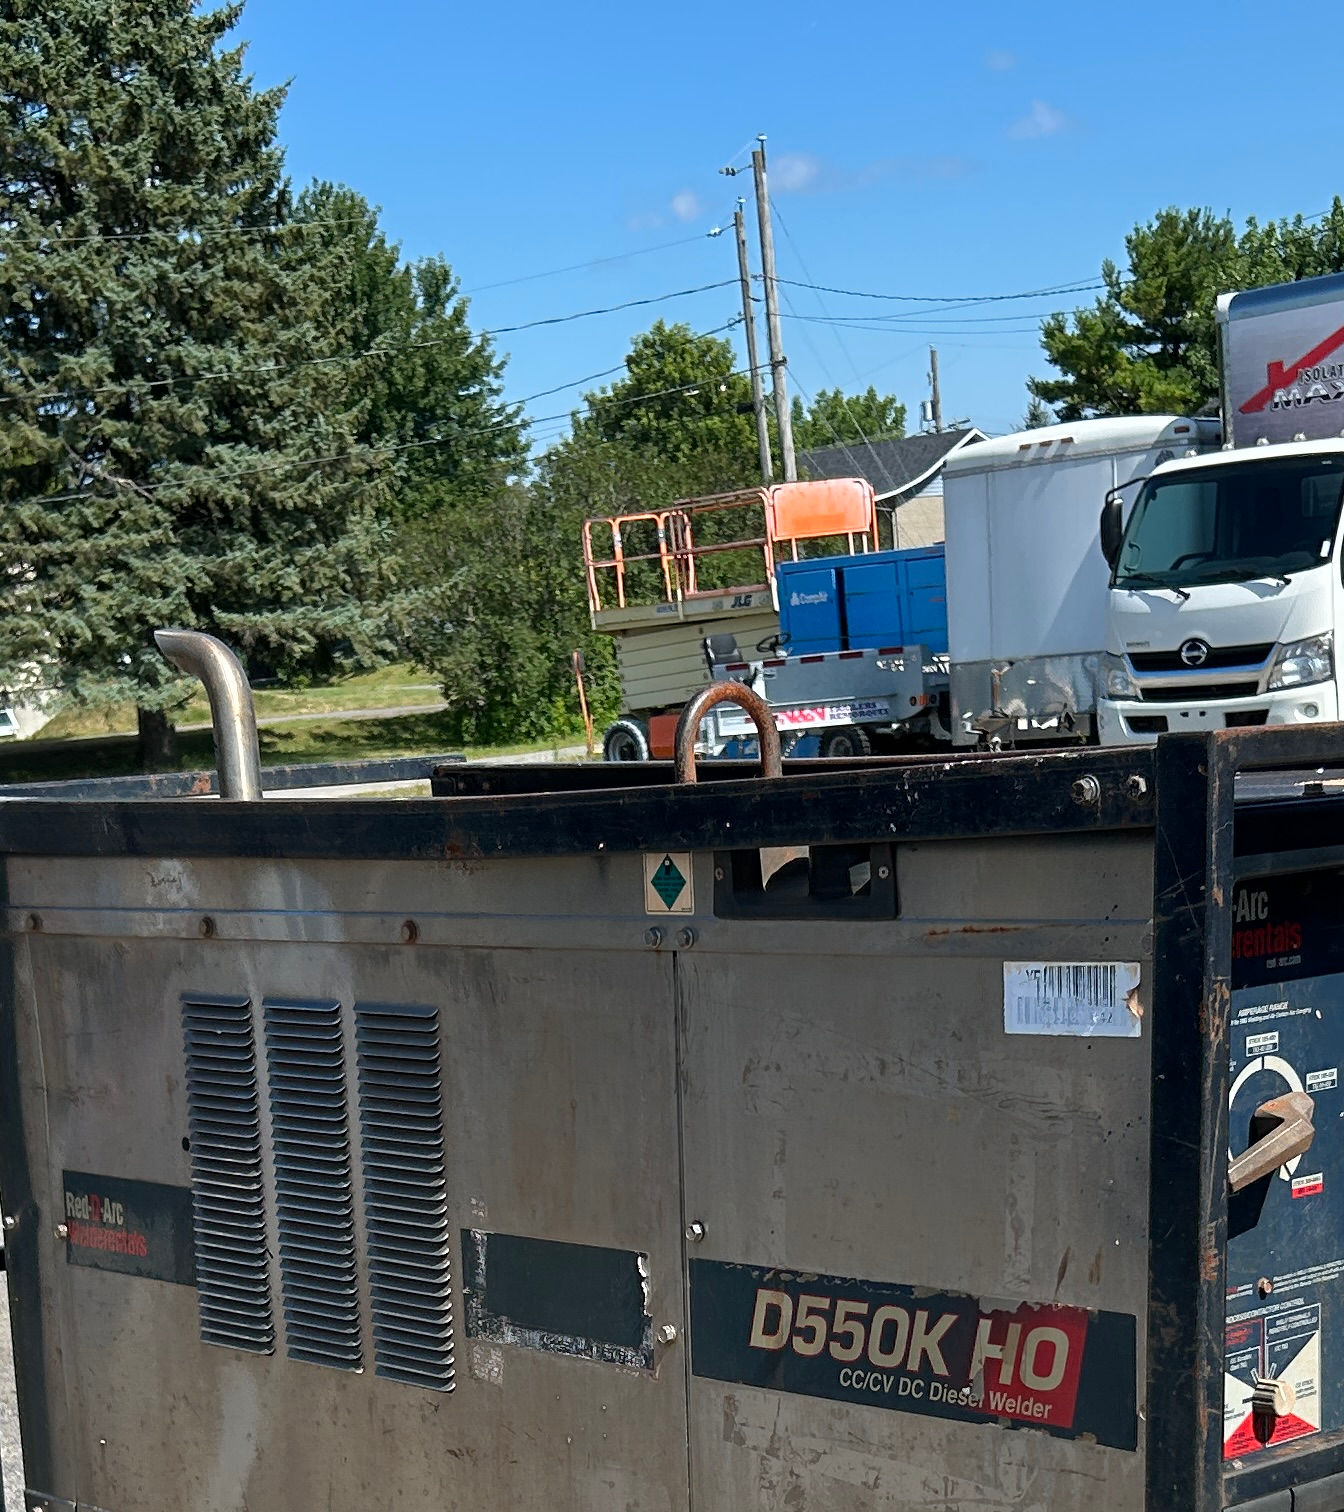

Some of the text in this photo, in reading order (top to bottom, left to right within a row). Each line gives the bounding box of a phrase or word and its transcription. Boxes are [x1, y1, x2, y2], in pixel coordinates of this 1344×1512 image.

[731, 595, 753, 608] JLG
[1232, 888, 1269, 923] -Arc
[1232, 920, 1303, 960] rentals
[748, 1286, 1071, 1392] D550K HO
[839, 1366, 1053, 1420] CC/CV DC Diesel Welder
